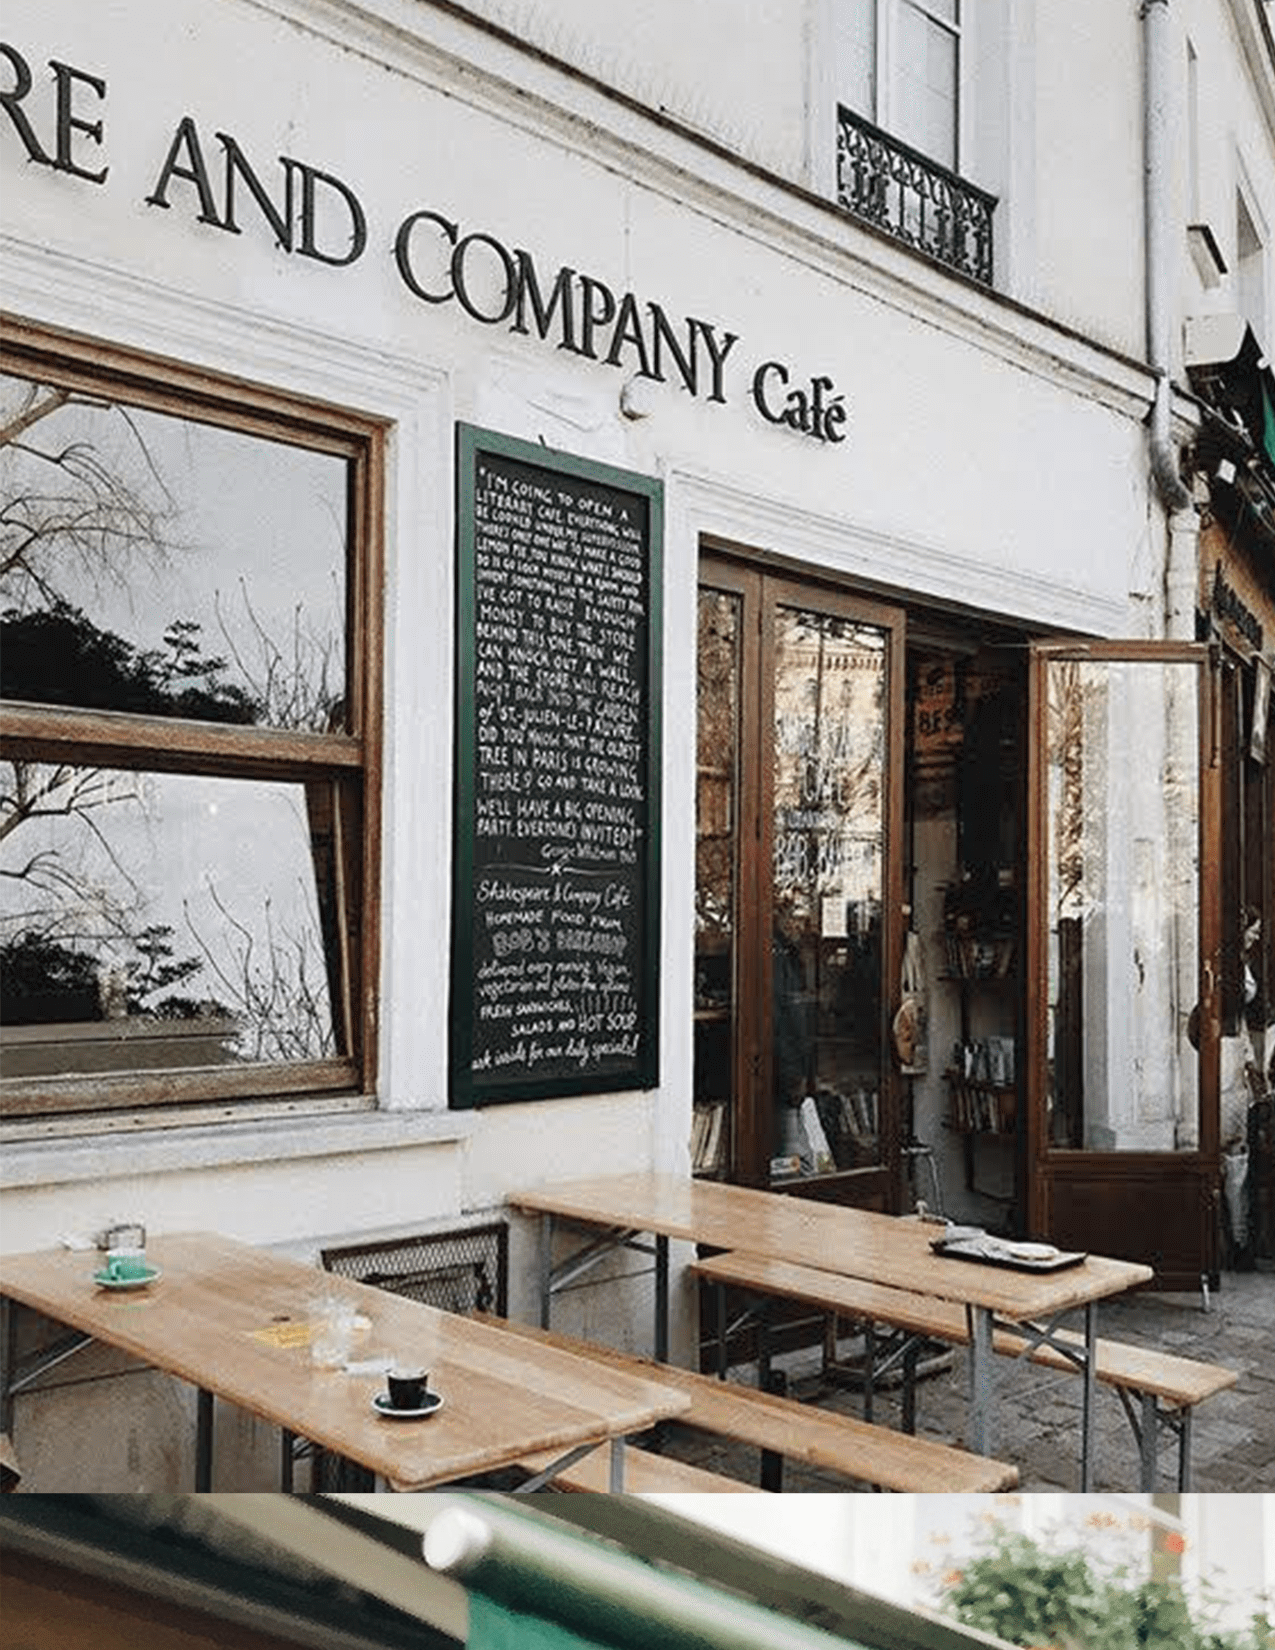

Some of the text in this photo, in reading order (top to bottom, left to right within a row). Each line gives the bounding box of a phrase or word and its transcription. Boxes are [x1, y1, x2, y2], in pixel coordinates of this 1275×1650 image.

[145, 117, 368, 268] AND
[394, 209, 739, 405] COMPANY
[752, 361, 847, 443] Café
[557, 492, 574, 506] TO
[577, 498, 612, 517] OPEN
[620, 510, 629, 521] A
[480, 604, 525, 627] MONEY
[551, 909, 586, 925] FOOD
[577, 1013, 604, 1033] HOT
